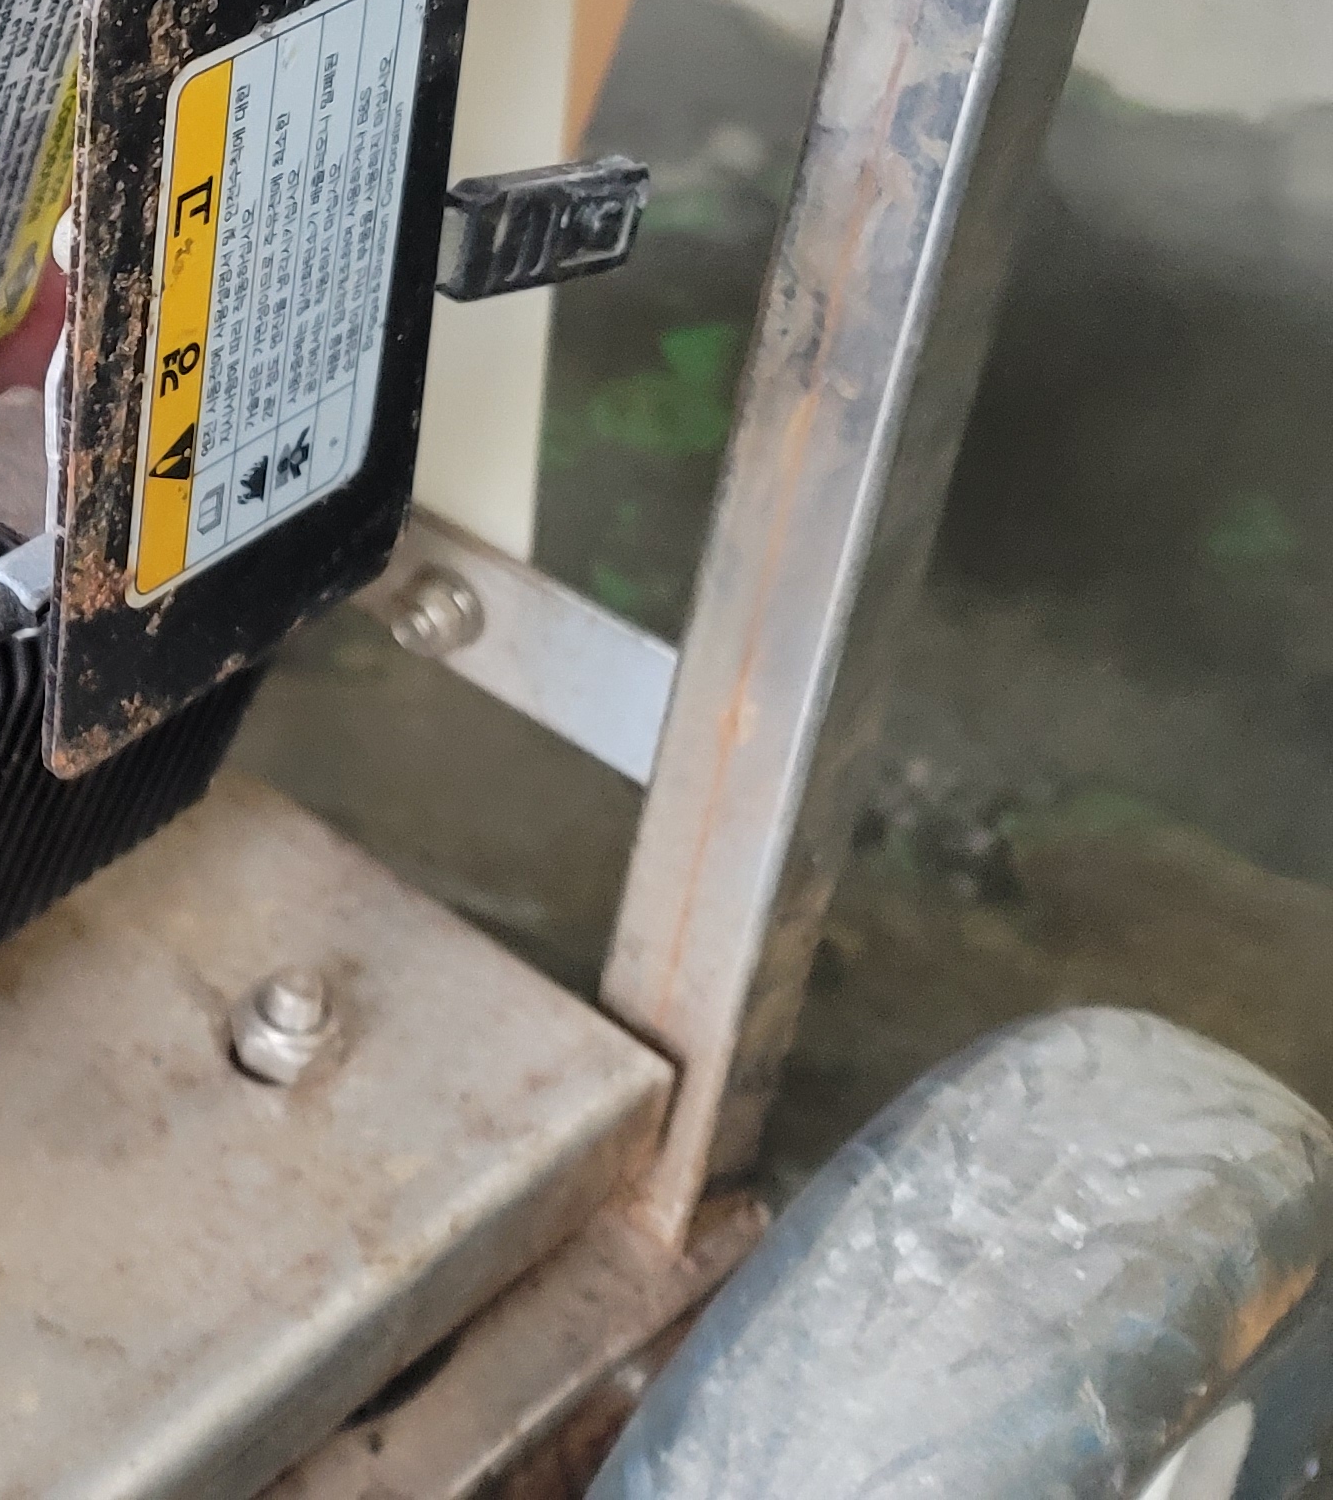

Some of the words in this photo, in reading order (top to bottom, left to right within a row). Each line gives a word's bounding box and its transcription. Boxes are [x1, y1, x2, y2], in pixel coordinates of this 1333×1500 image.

[270, 109, 291, 170] 최소한
[355, 83, 372, 127] B&S
[379, 98, 406, 209] Corporation
[172, 173, 214, 240] 고
[275, 158, 303, 293] 냉각시키십시오
[322, 152, 344, 233] 마십시오
[199, 418, 218, 458] 엔진
[232, 81, 251, 123] 대한
[232, 198, 256, 315] 작동하십시오
[369, 210, 390, 283] Stratton
[360, 292, 381, 353] Briggs
[159, 335, 201, 399] 경
